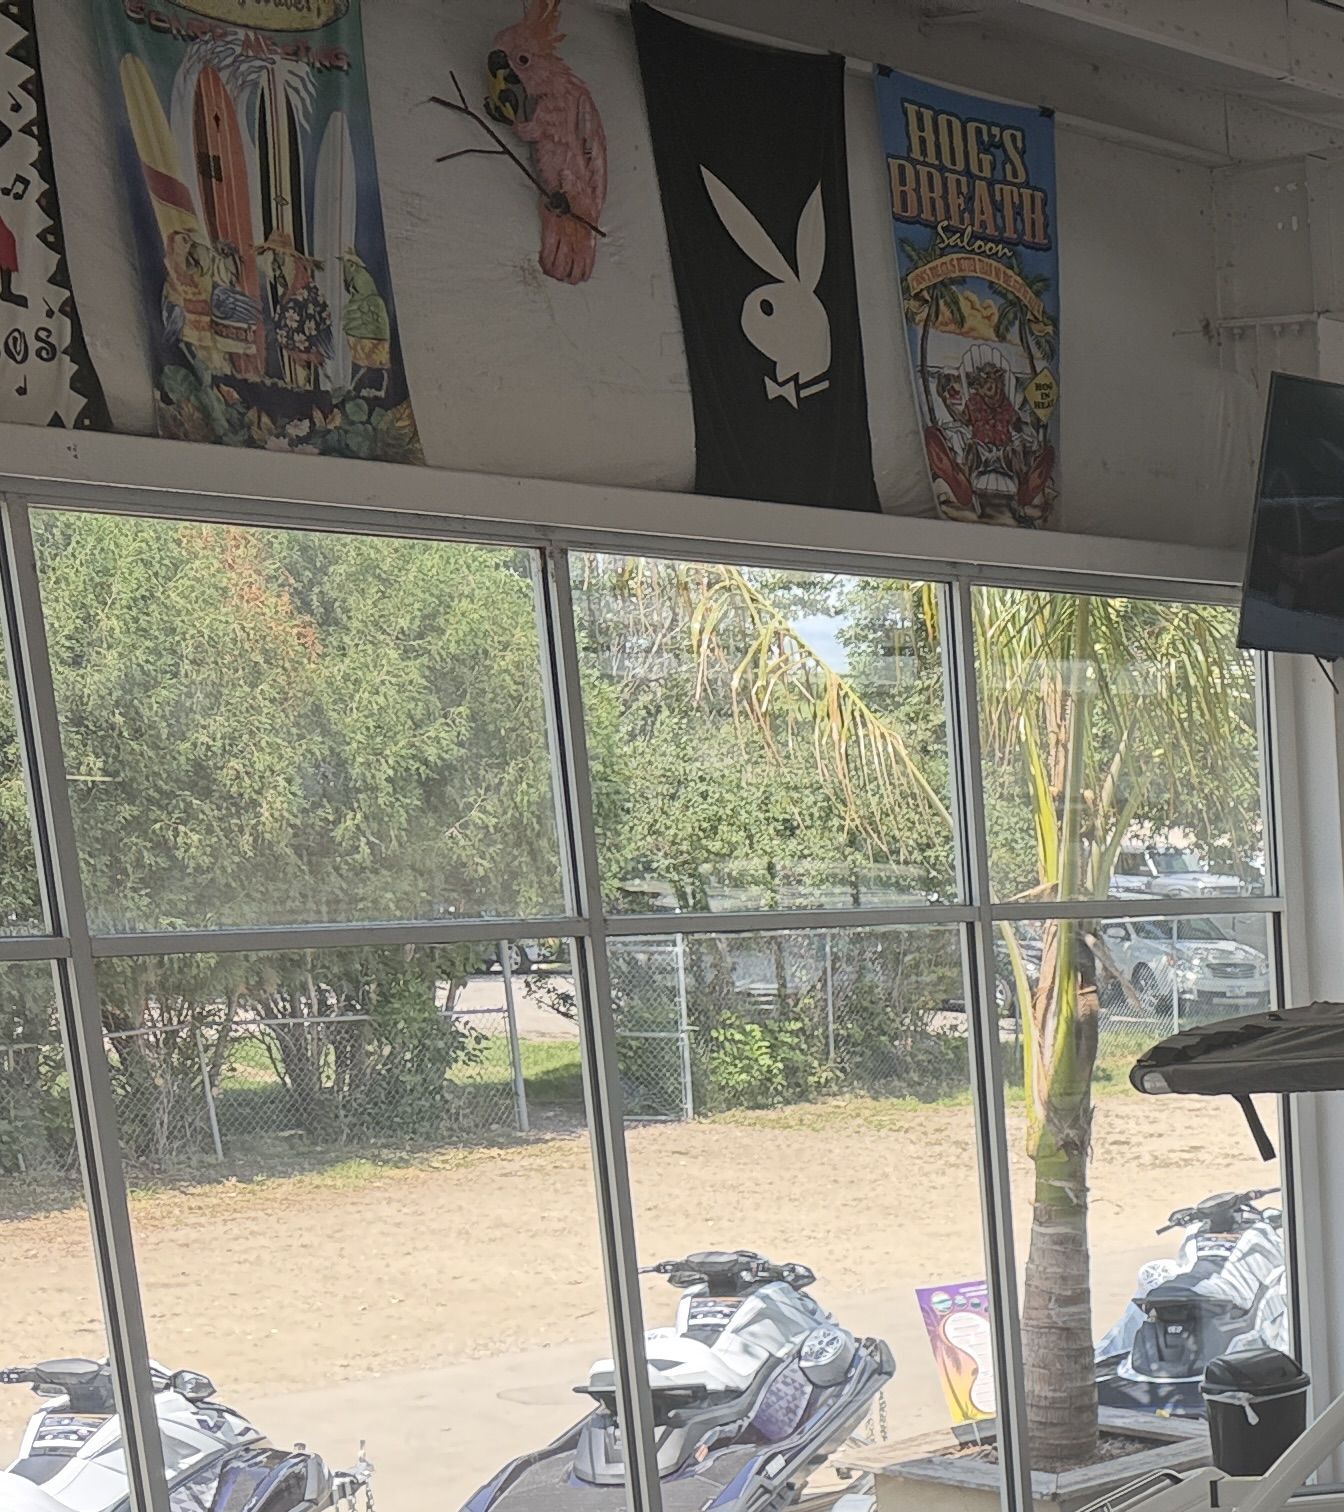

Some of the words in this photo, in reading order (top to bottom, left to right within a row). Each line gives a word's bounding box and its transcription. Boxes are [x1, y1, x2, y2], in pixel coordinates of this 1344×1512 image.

[903, 101, 1027, 184] HOG'S
[887, 157, 1050, 246] BREATH
[936, 219, 1014, 257] Saloon
